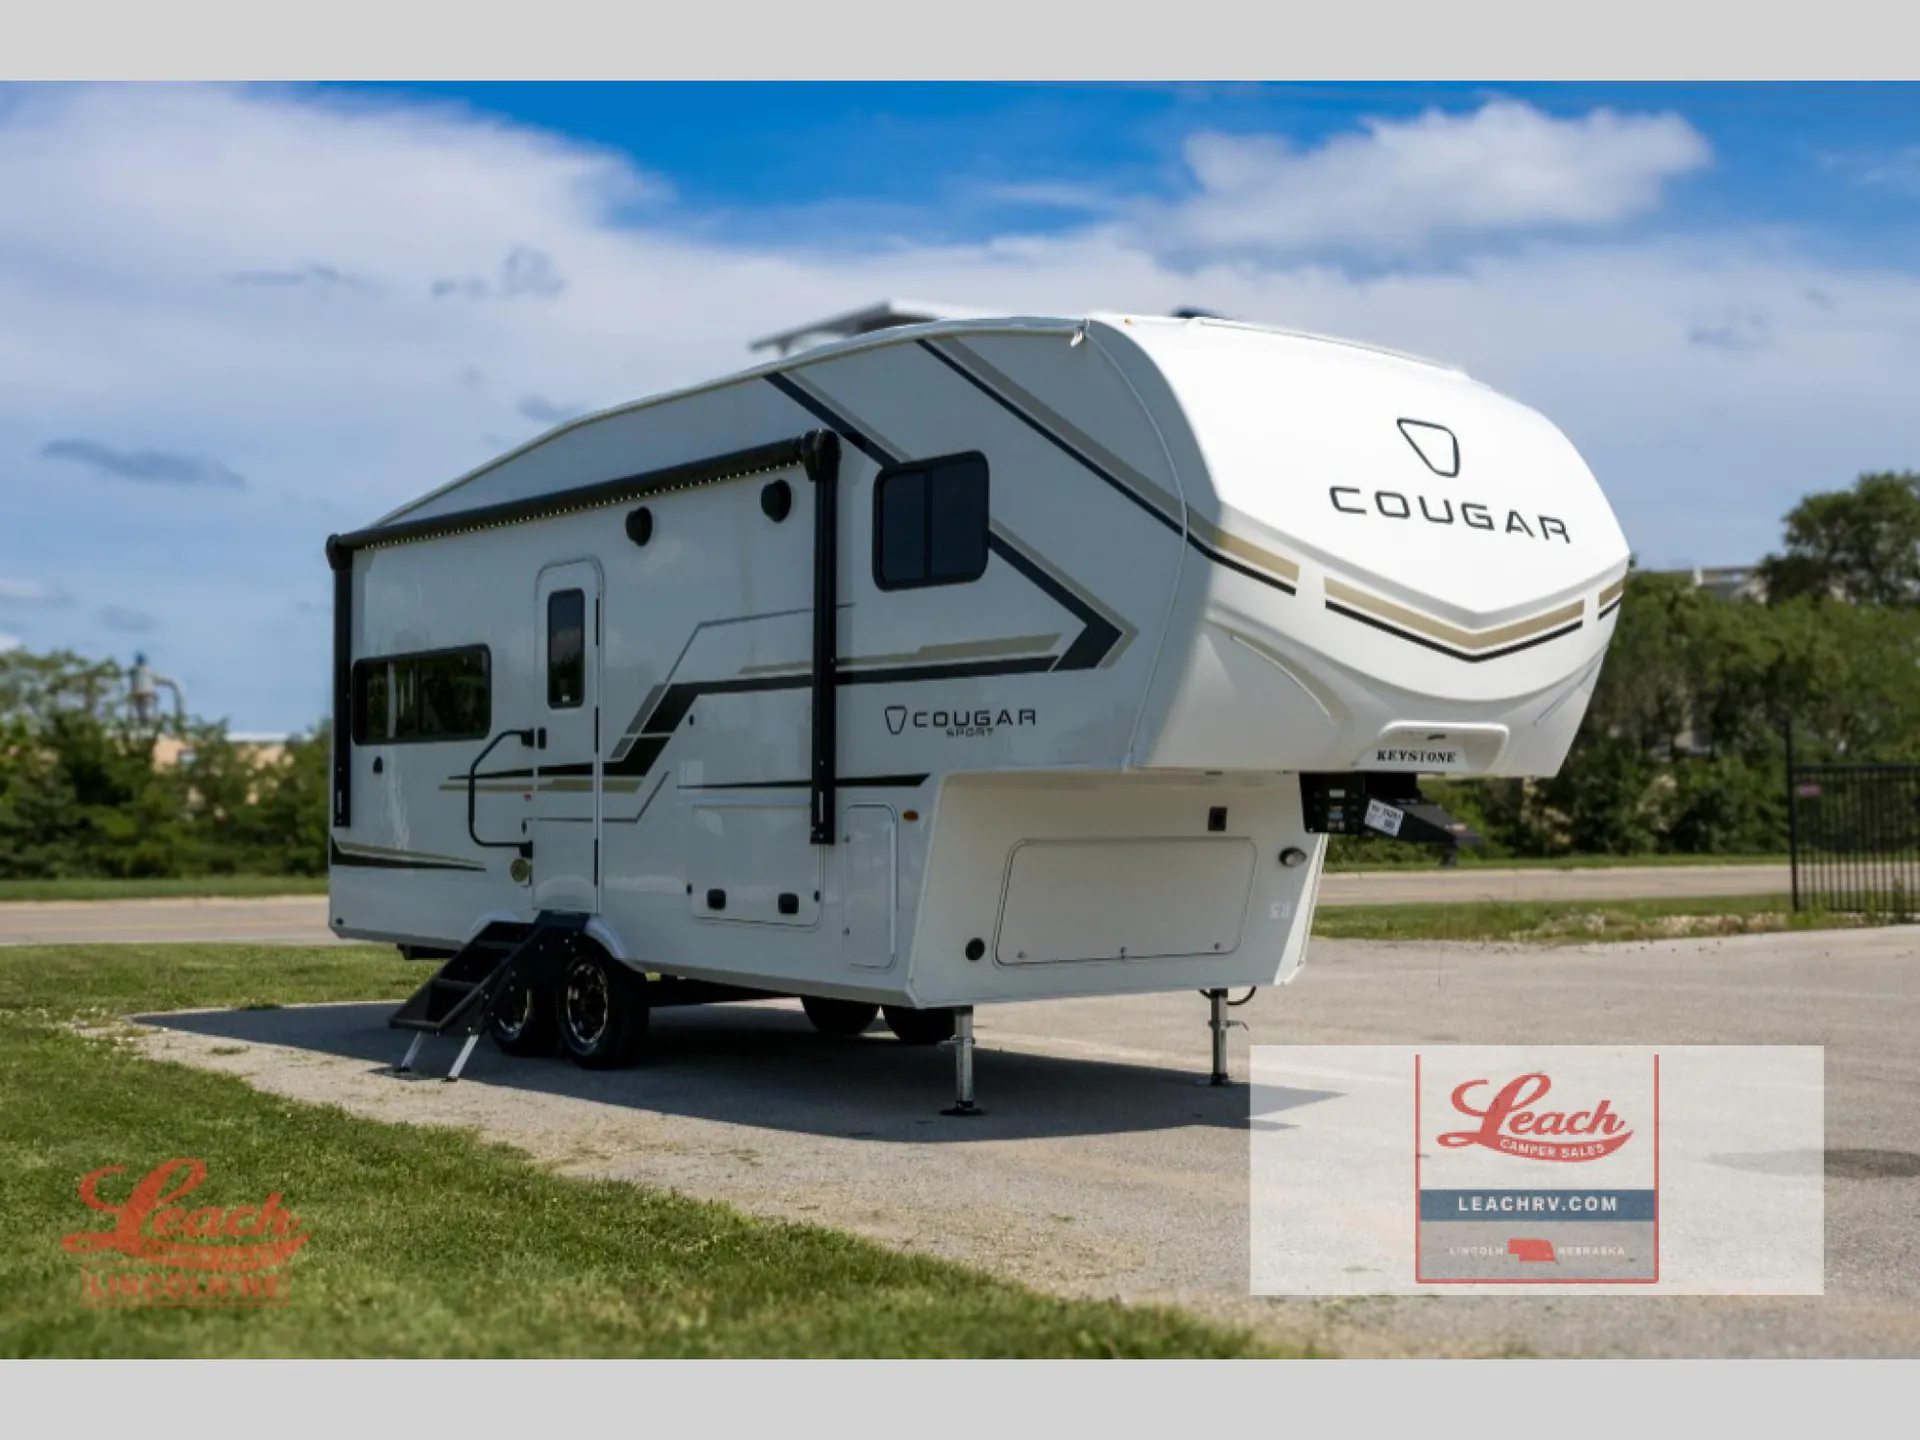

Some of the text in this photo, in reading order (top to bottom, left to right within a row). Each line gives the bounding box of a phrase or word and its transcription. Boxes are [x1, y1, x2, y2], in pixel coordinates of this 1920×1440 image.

[1329, 486, 1570, 544] COUGAR
[912, 709, 1036, 728] COUGAR
[946, 727, 994, 738] SPORT
[1376, 750, 1456, 764] KEYSTONE
